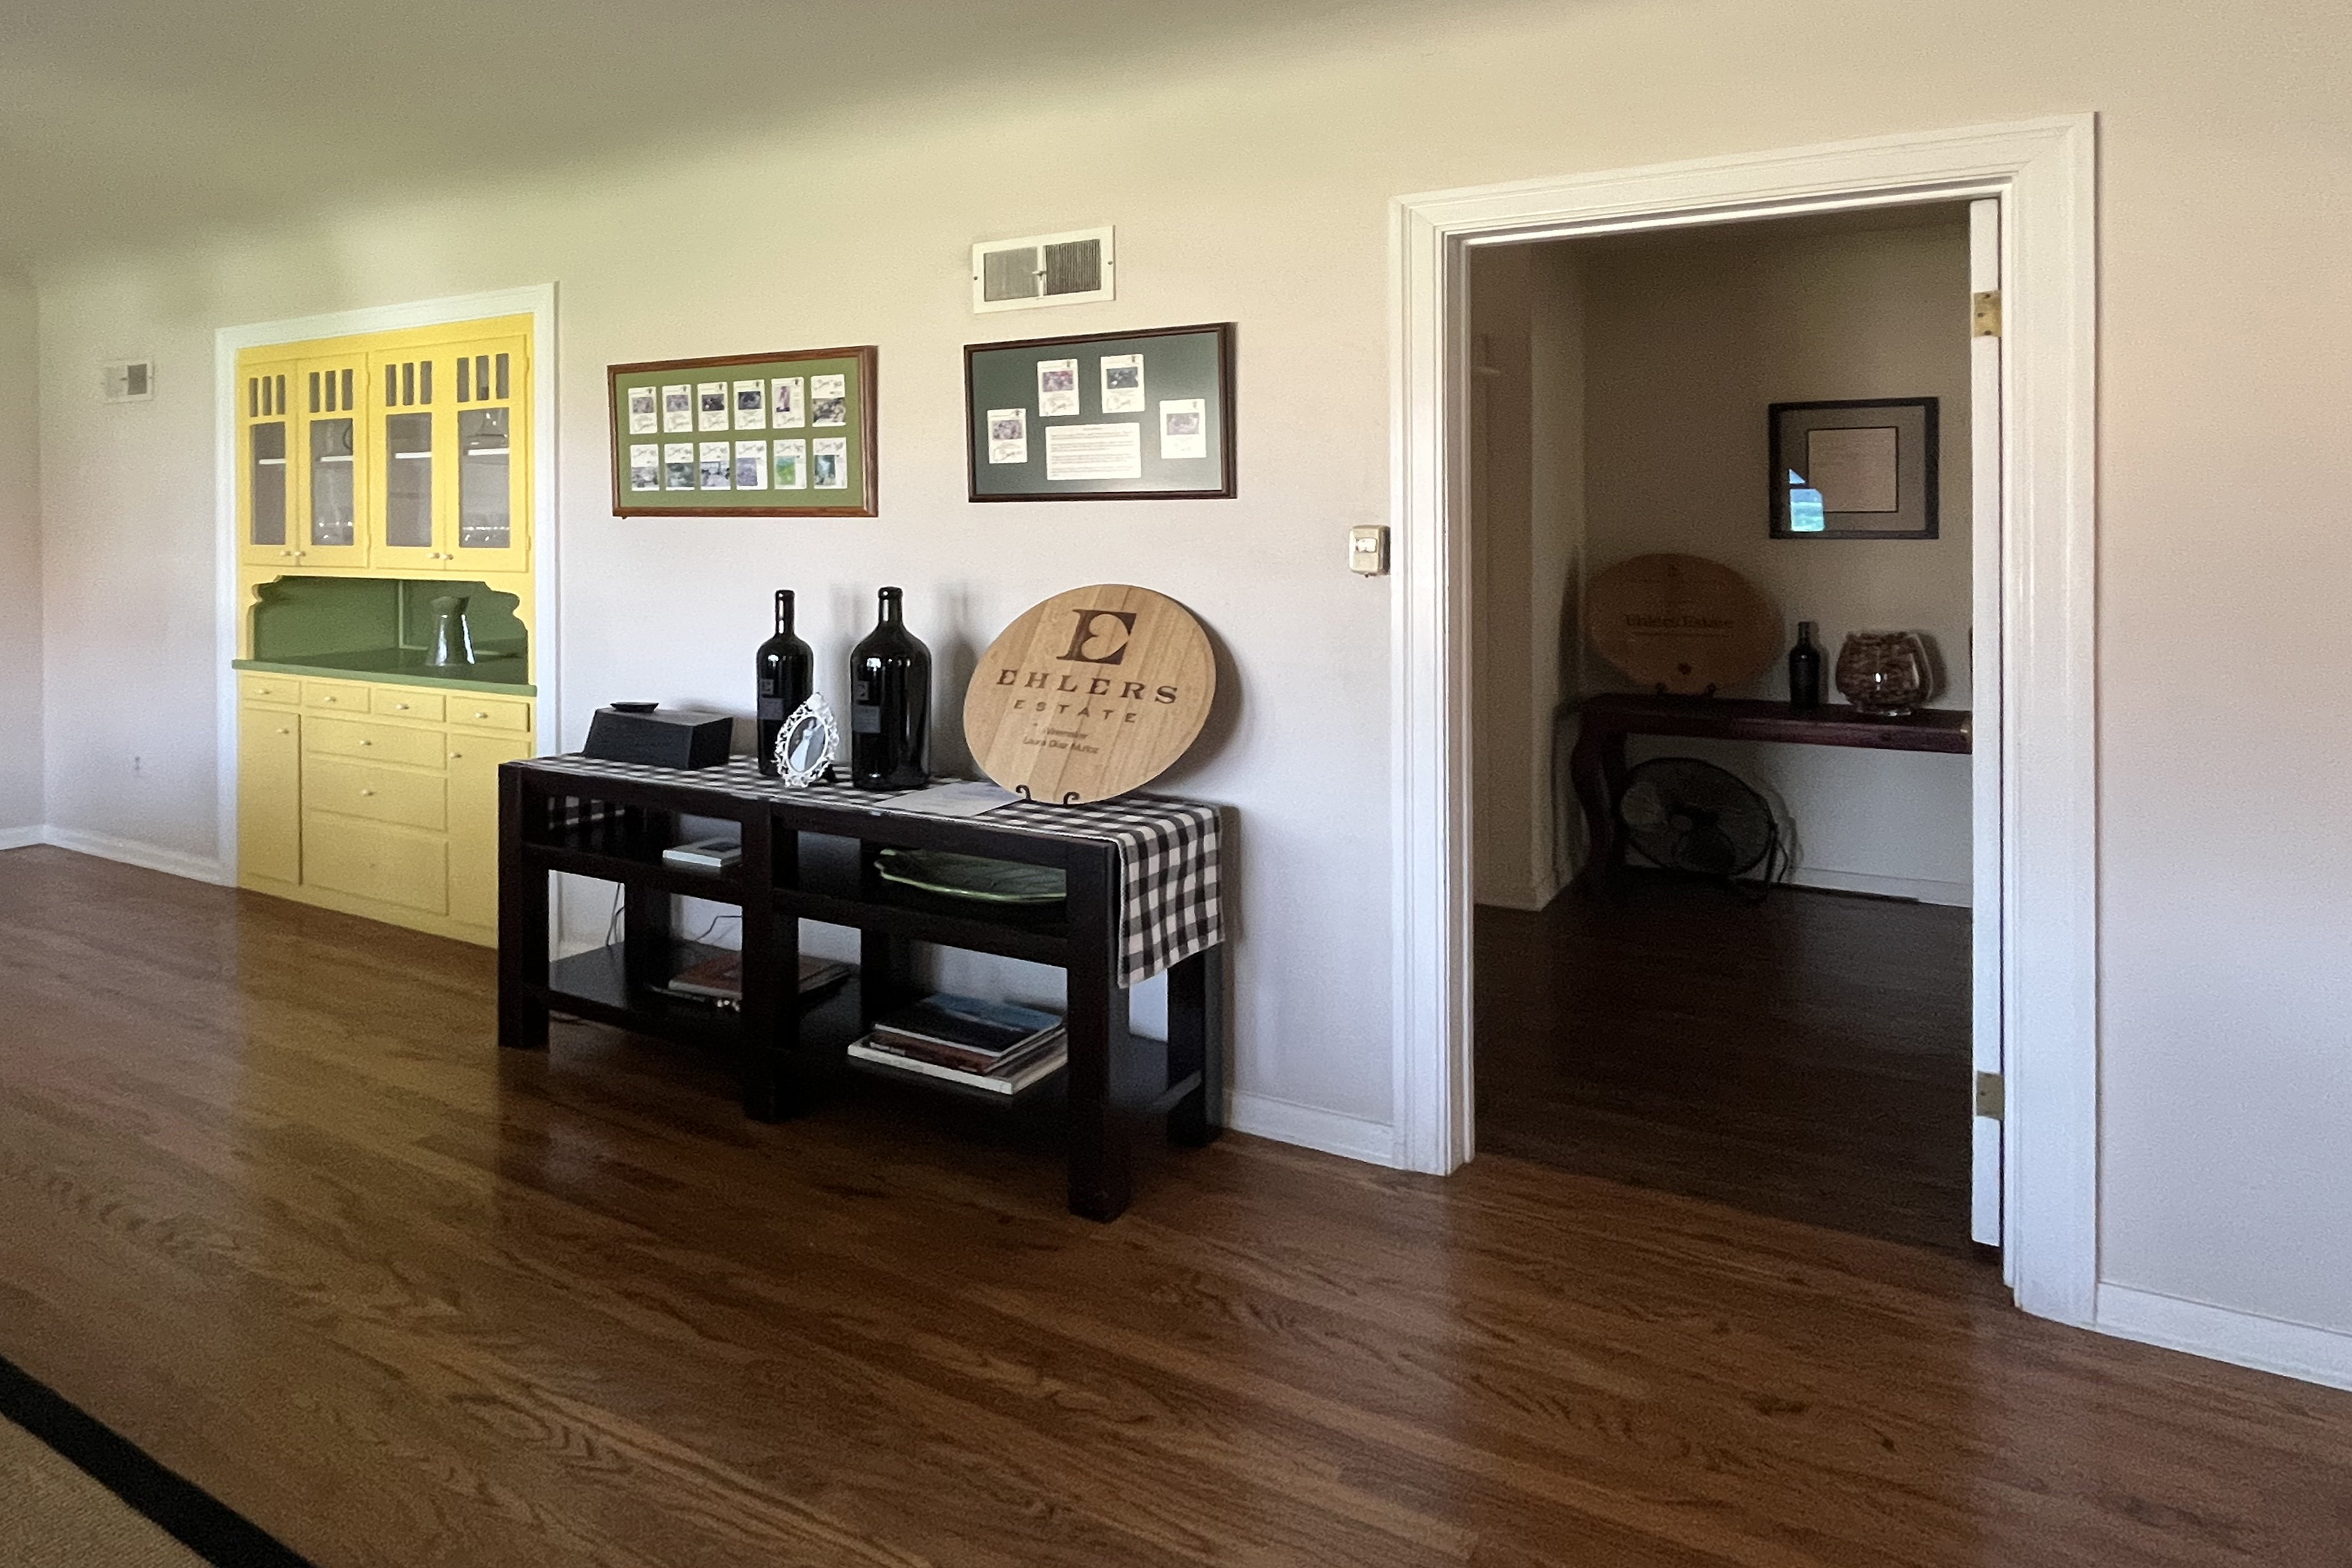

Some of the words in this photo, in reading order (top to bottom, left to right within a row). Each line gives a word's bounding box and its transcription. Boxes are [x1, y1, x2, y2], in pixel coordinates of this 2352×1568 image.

[1056, 608, 1137, 665] E
[996, 669, 1178, 705] EHLERS
[1013, 699, 1137, 724] ESTATE
